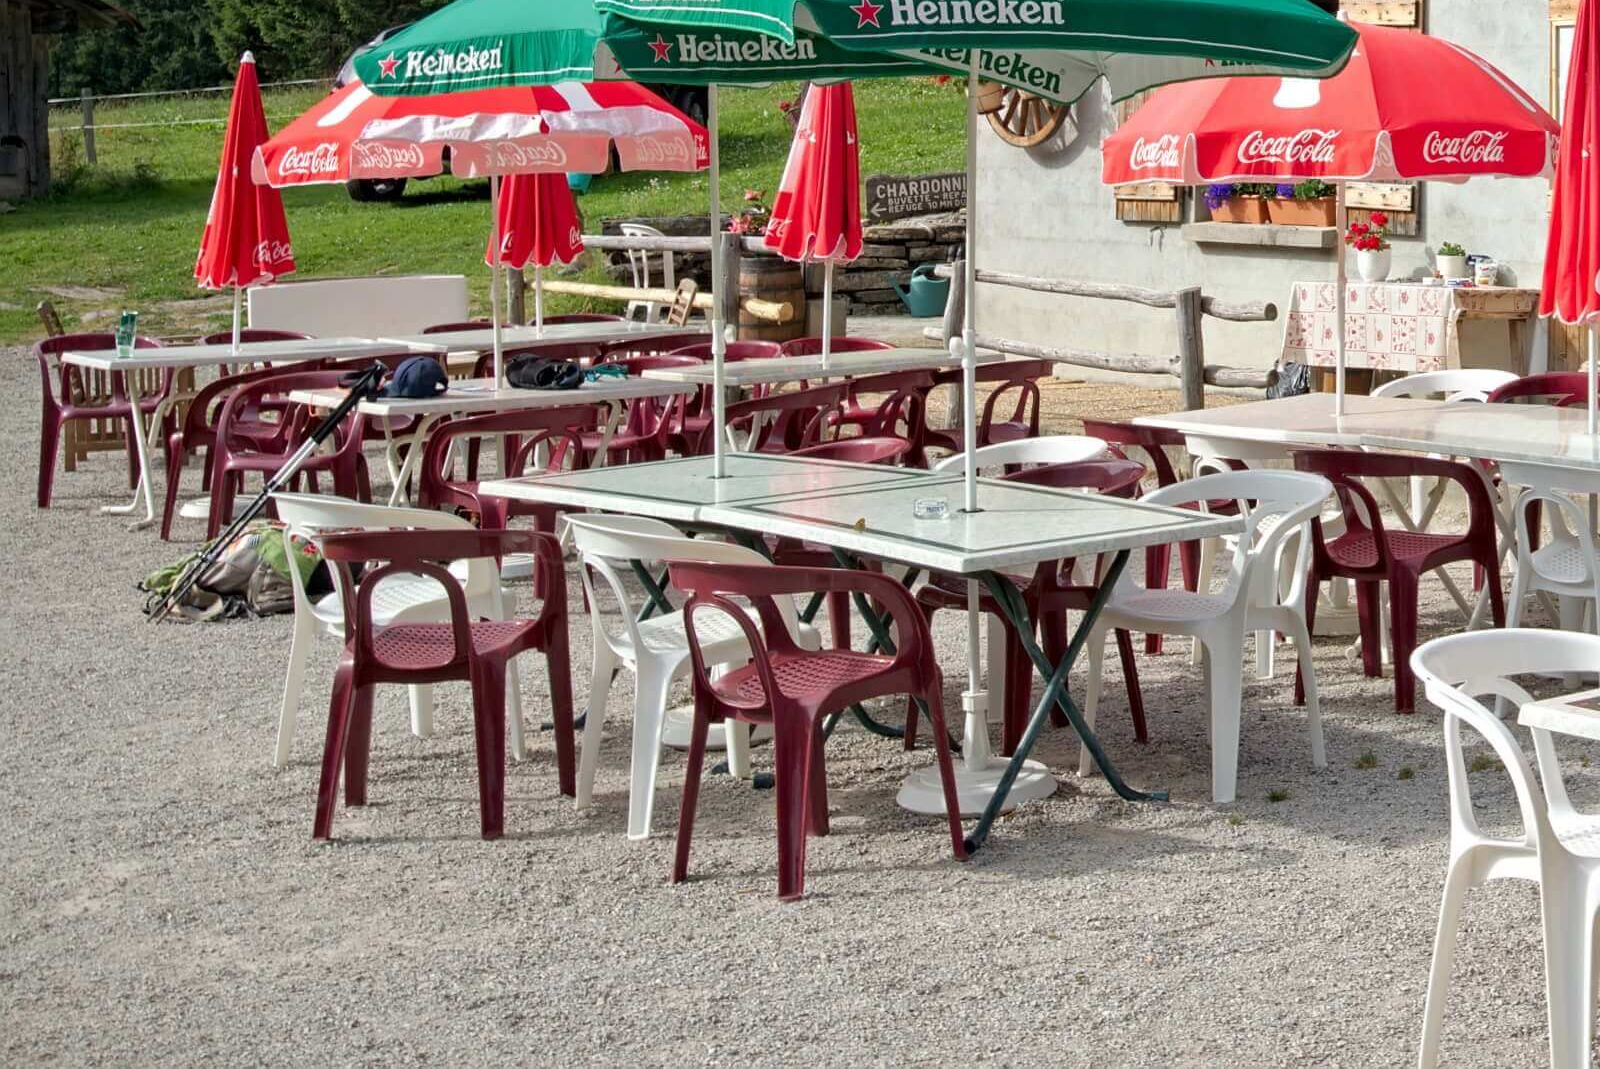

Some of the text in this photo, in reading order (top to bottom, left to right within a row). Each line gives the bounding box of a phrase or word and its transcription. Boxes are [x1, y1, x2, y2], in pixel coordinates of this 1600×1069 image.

[405, 44, 503, 78] Heineken
[676, 34, 817, 63] Heineken
[279, 141, 341, 176] Coca-Cola
[1129, 134, 1180, 170] Coca-Cola
[1237, 129, 1343, 164] Coca-Cola
[1423, 130, 1510, 163] Coca-Cola
[888, 194, 931, 205] BUVETTE
[888, 202, 923, 213] REFUGE
